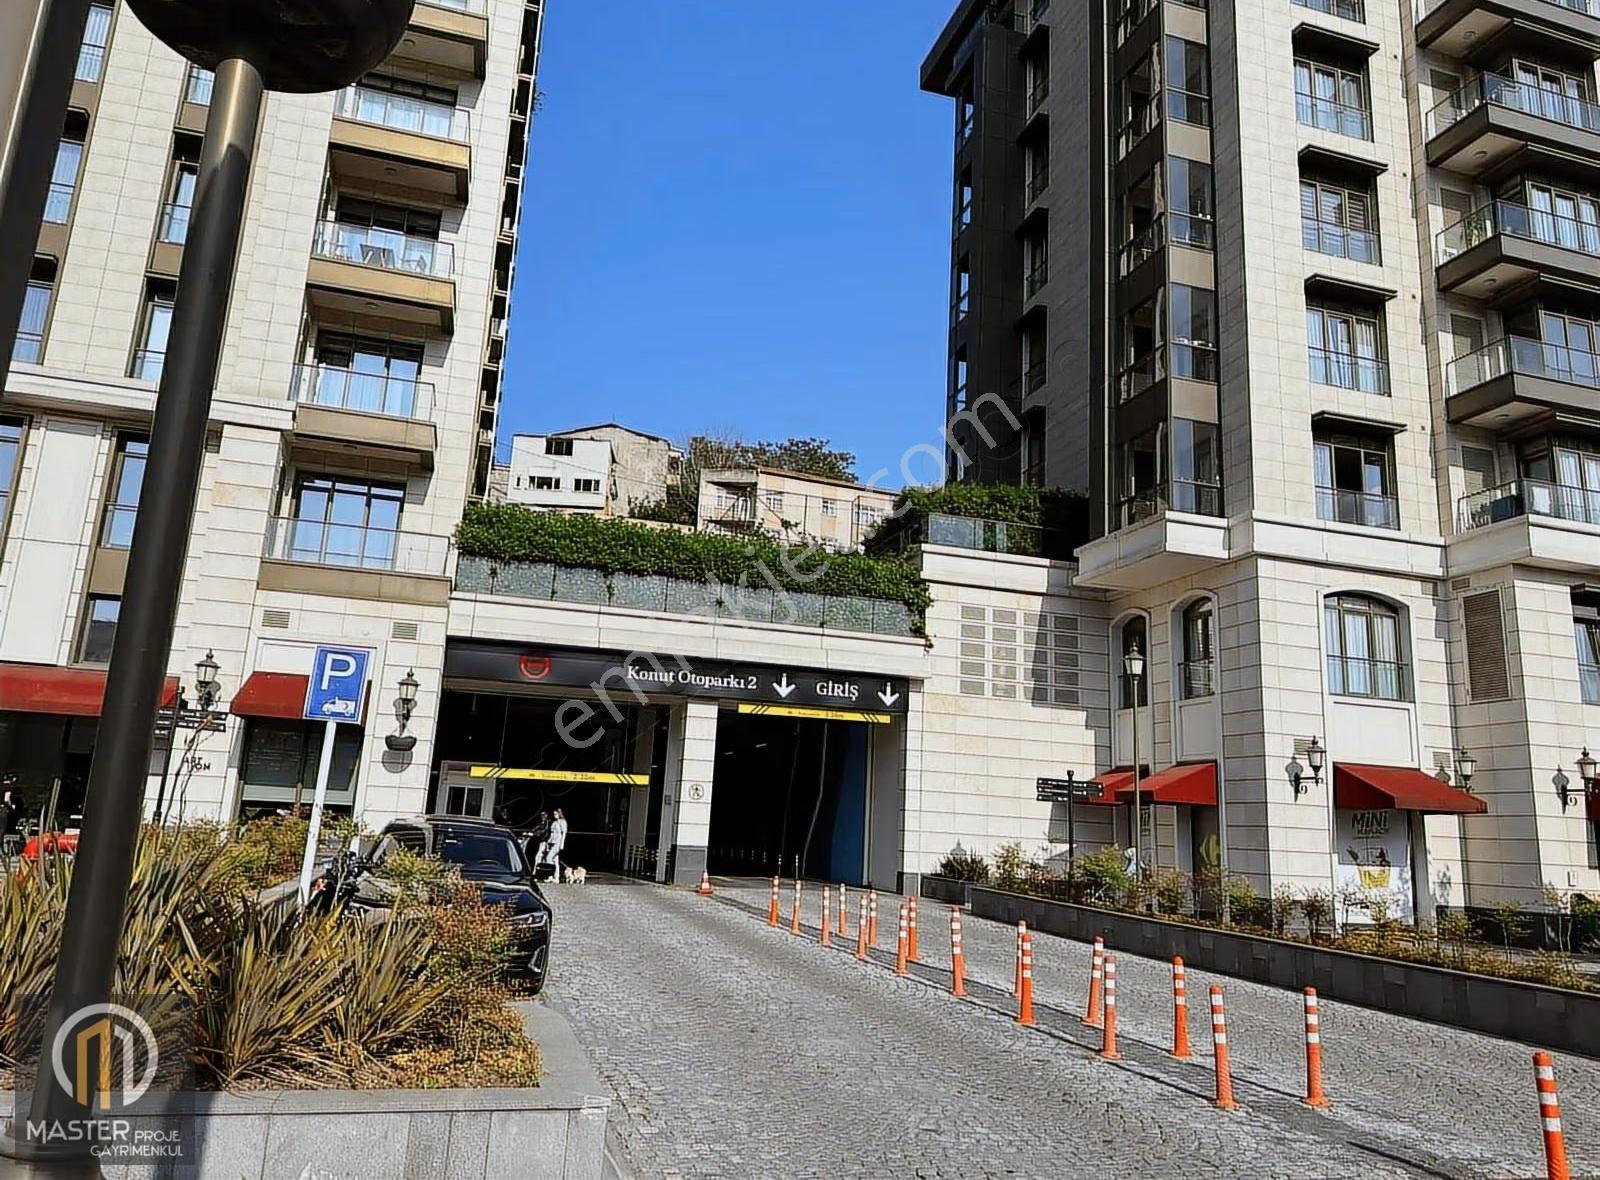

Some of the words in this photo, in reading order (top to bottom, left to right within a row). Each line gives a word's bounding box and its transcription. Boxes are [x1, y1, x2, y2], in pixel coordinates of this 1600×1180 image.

[320, 652, 357, 691] P
[626, 665, 675, 683] Konut
[747, 676, 758, 690] 2
[816, 680, 859, 702] GİRİŞ
